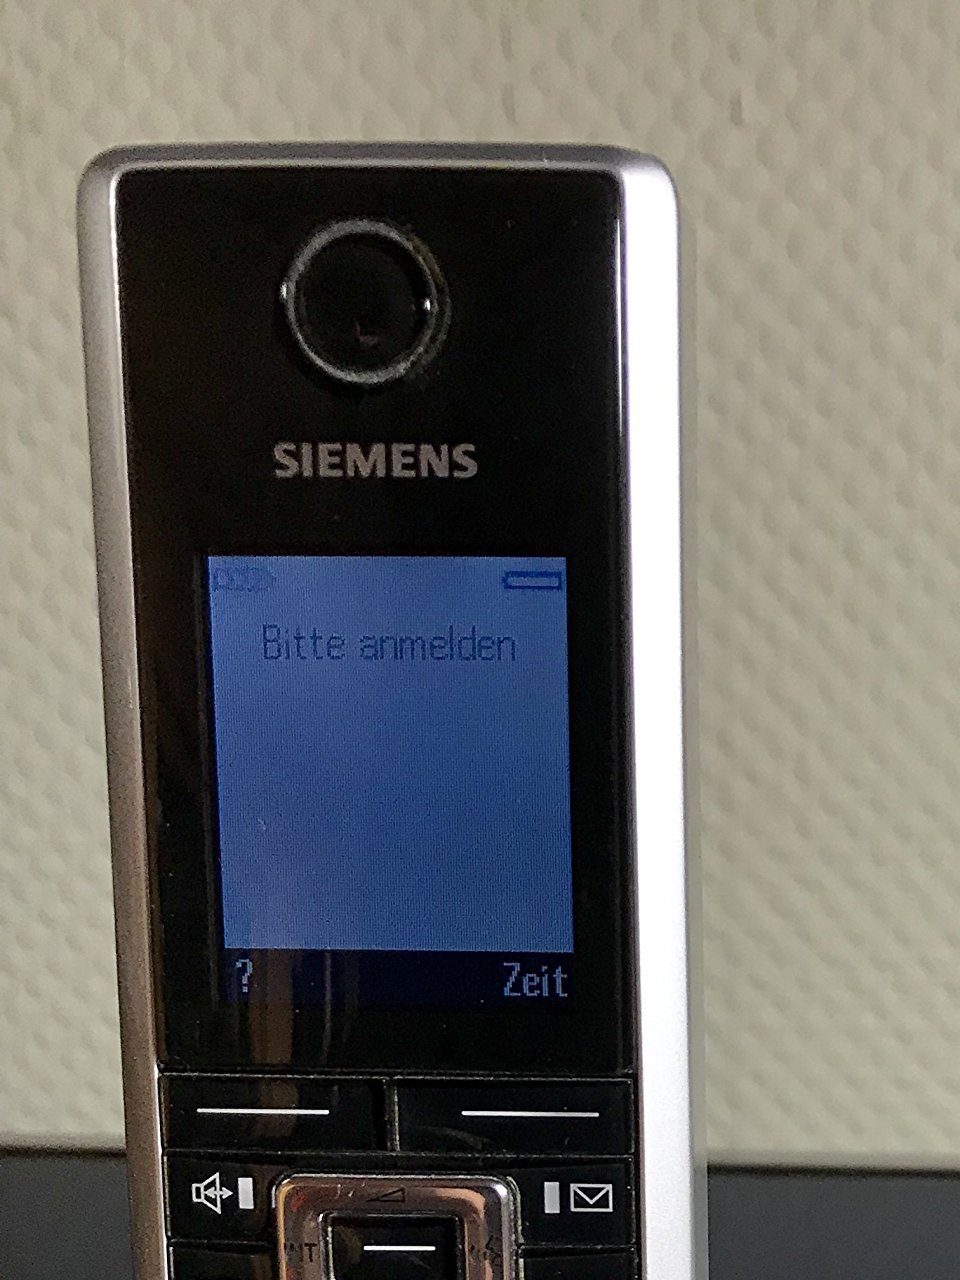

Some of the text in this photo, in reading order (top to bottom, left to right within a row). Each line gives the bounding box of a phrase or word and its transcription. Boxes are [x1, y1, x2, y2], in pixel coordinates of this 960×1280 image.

[272, 442, 479, 480] SIEMENS
[262, 624, 517, 662] Bitte anmelden
[235, 958, 254, 993] ?
[503, 963, 569, 998] Zeit
